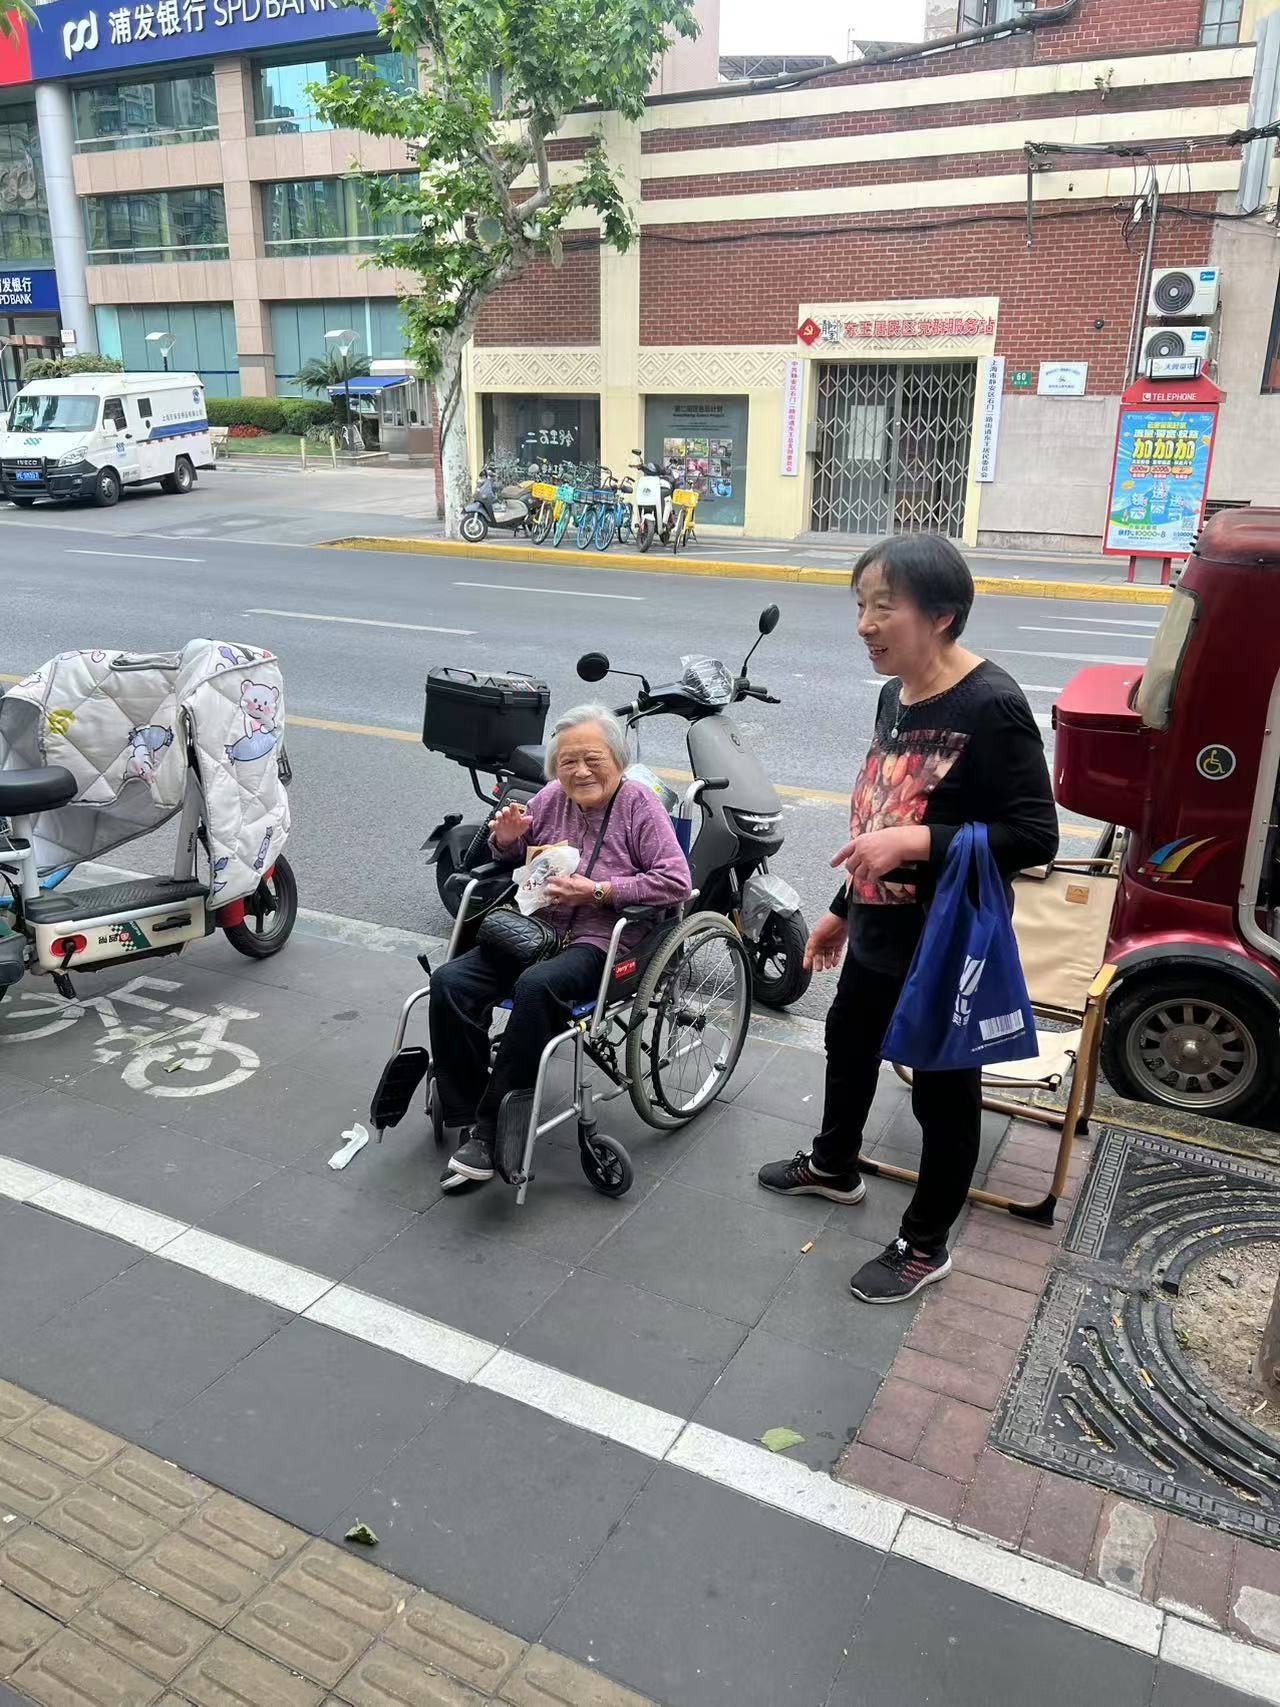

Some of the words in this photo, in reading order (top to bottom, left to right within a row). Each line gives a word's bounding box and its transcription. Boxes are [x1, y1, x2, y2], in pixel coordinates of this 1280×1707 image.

[213, 0, 260, 26] SPD
[265, 0, 338, 19] BAN
[108, 0, 207, 45] 浦发银行
[0, 277, 32, 293] 发银行
[9, 293, 33, 305] BANK
[1016, 372, 1027, 381] 60
[1152, 392, 1198, 401] TELEPHONE
